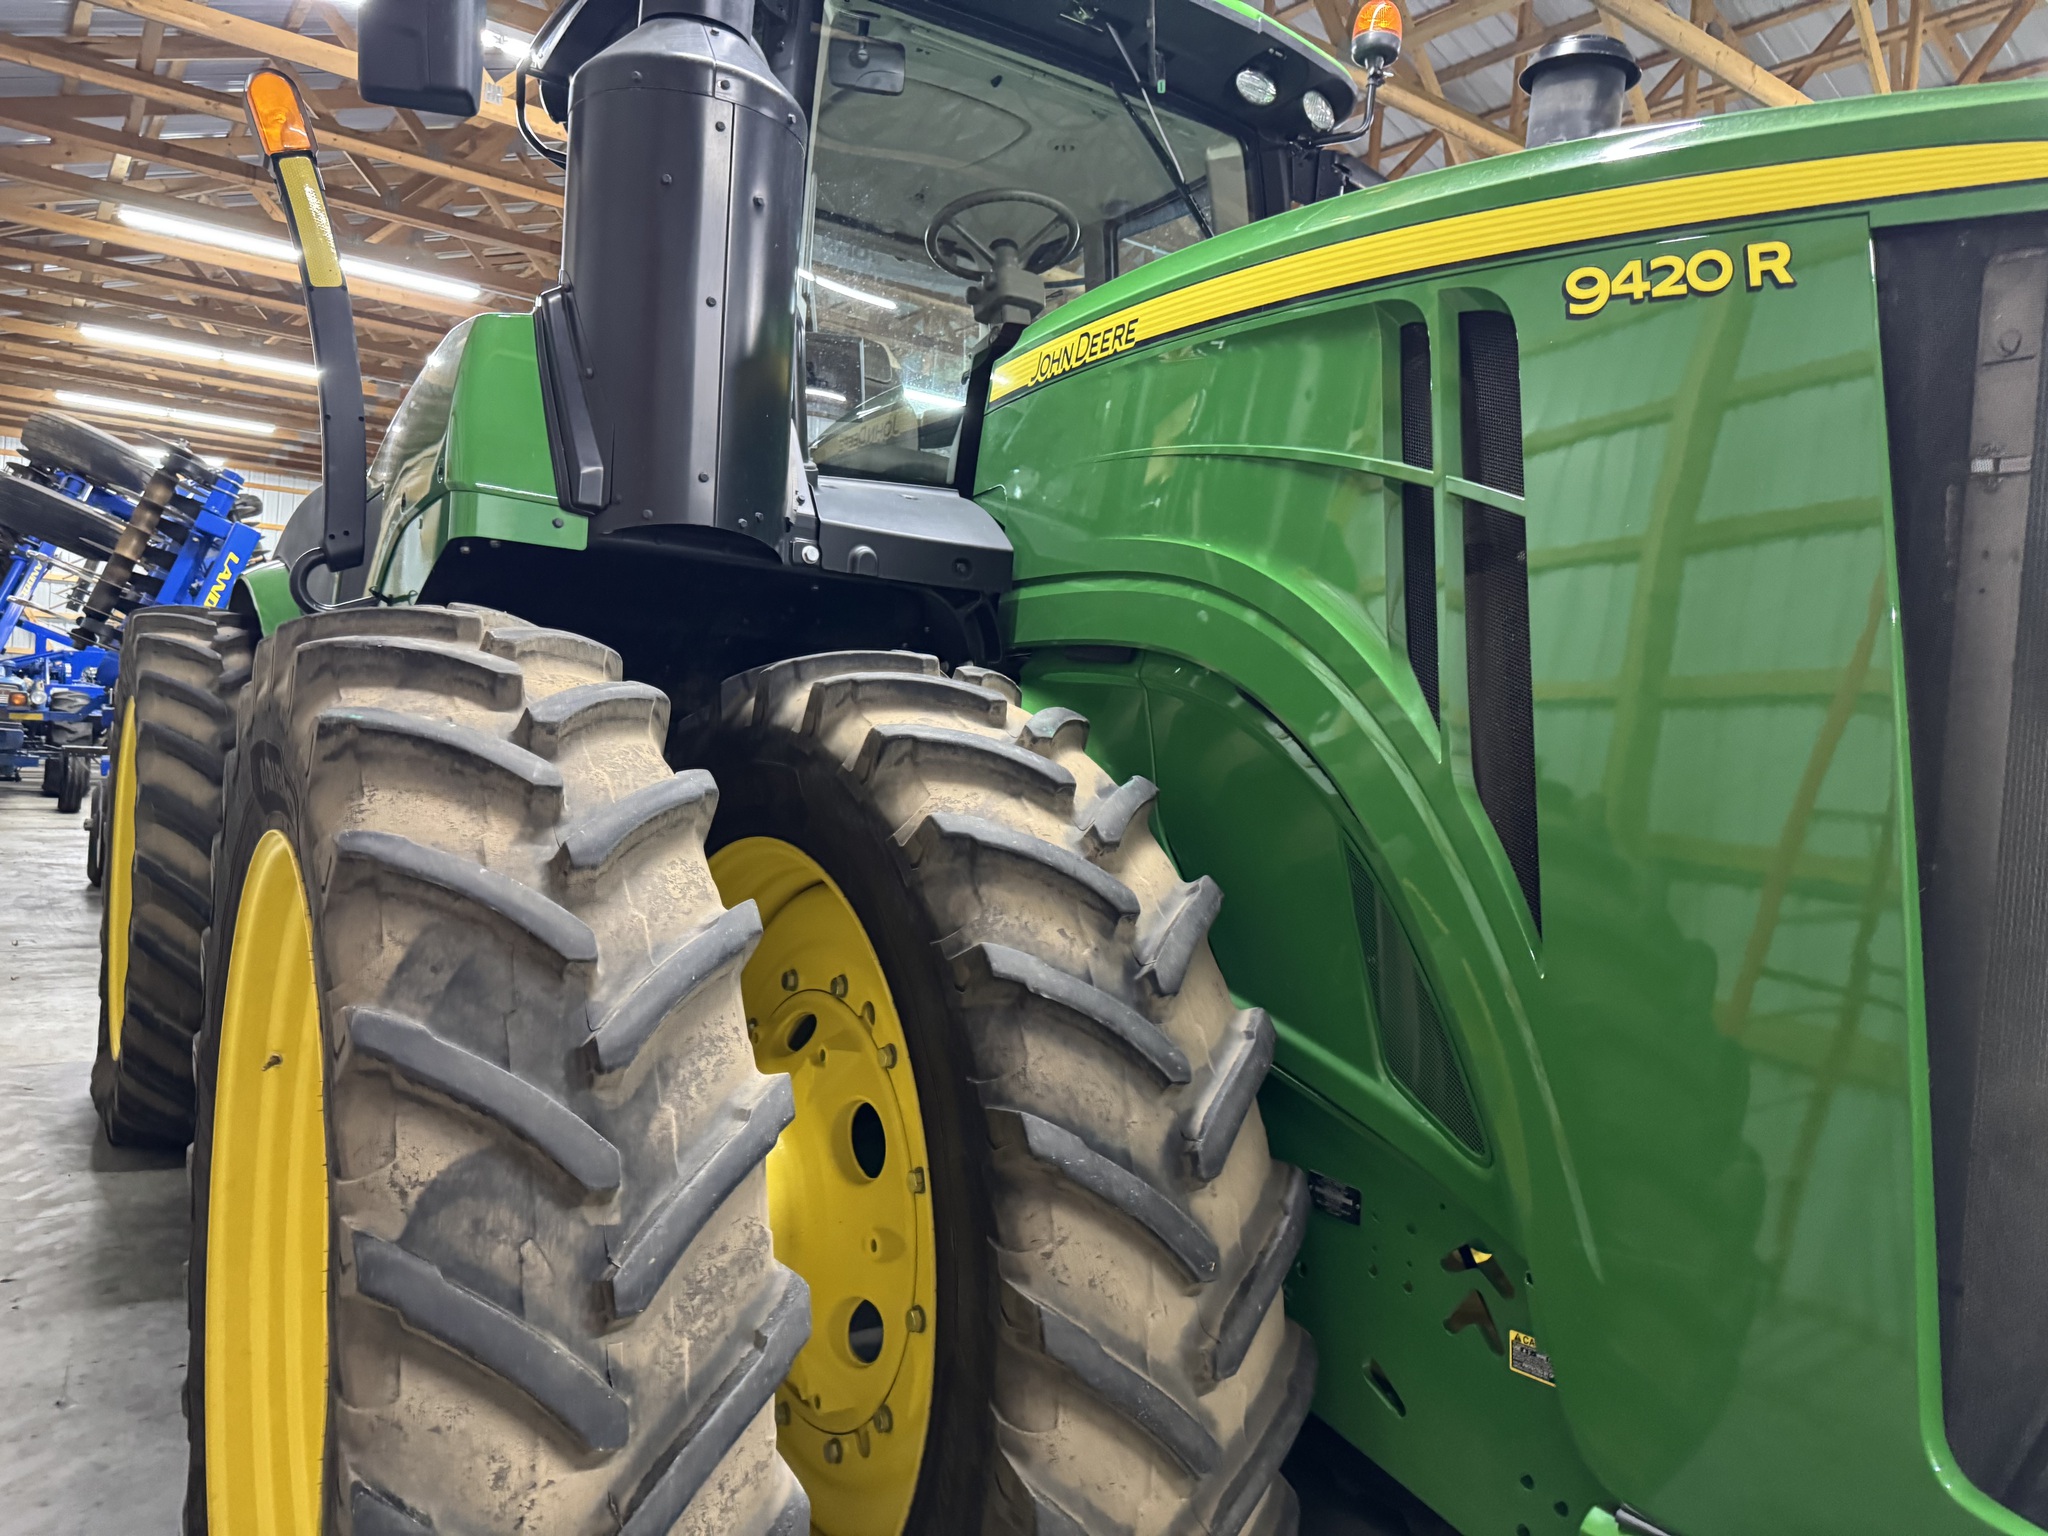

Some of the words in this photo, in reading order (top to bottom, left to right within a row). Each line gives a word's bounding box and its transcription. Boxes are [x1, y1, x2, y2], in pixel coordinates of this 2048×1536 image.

[1561, 249, 1734, 320] 9420
[1743, 240, 1797, 293] R
[1028, 341, 1075, 386] JOHN
[1075, 317, 1140, 366] DEERE
